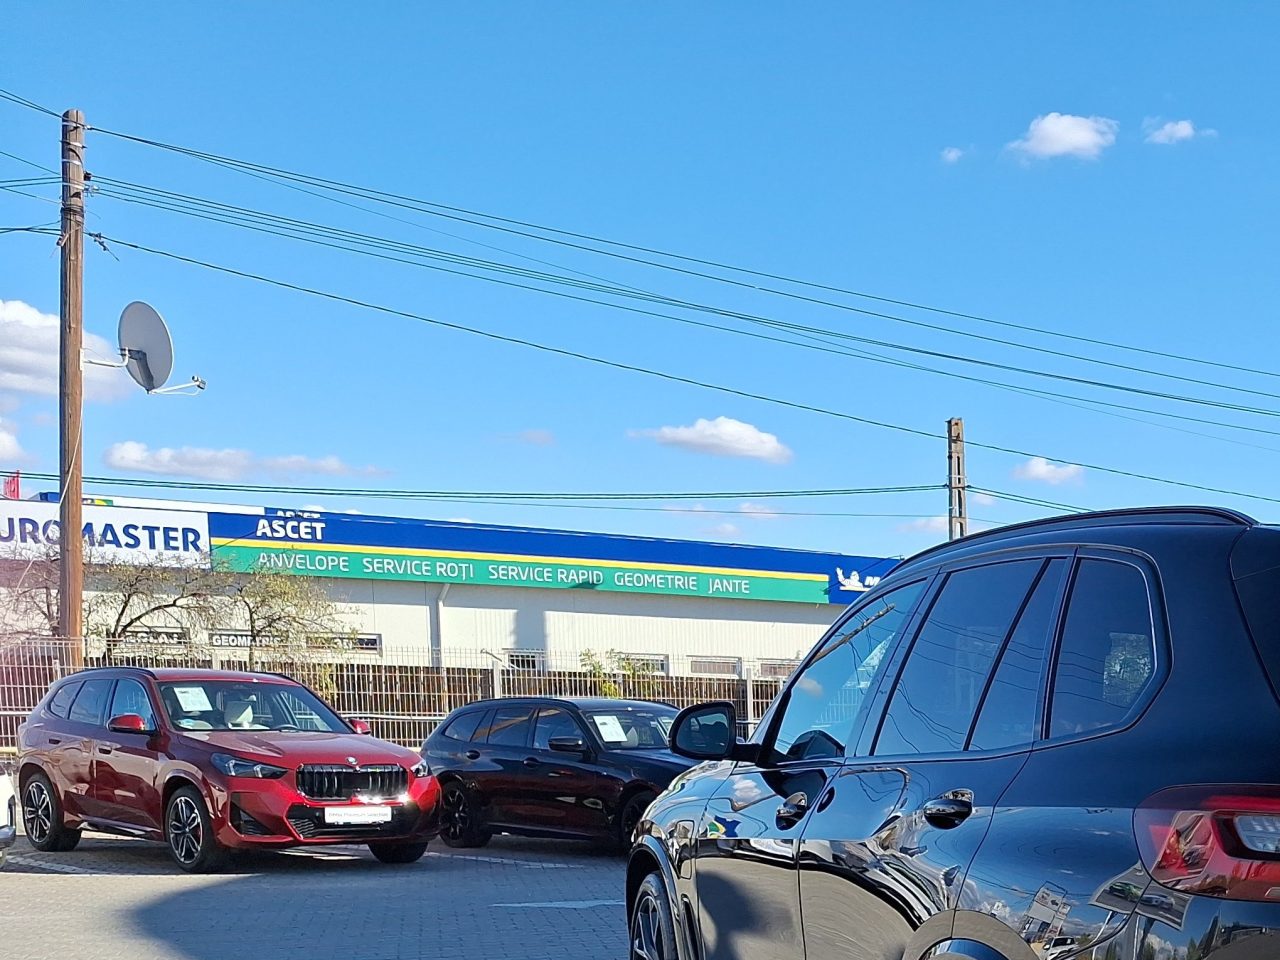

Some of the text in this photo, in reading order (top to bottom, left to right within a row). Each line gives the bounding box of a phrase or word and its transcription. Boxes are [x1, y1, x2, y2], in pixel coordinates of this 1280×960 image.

[257, 519, 326, 540] ASCET
[259, 552, 350, 572] ANVELOPE
[362, 558, 432, 576] SERVICE
[488, 565, 552, 583] SERVICE
[557, 568, 604, 585] RAPID
[614, 572, 698, 590] GEOMETRIE
[708, 578, 750, 594] JANTE
